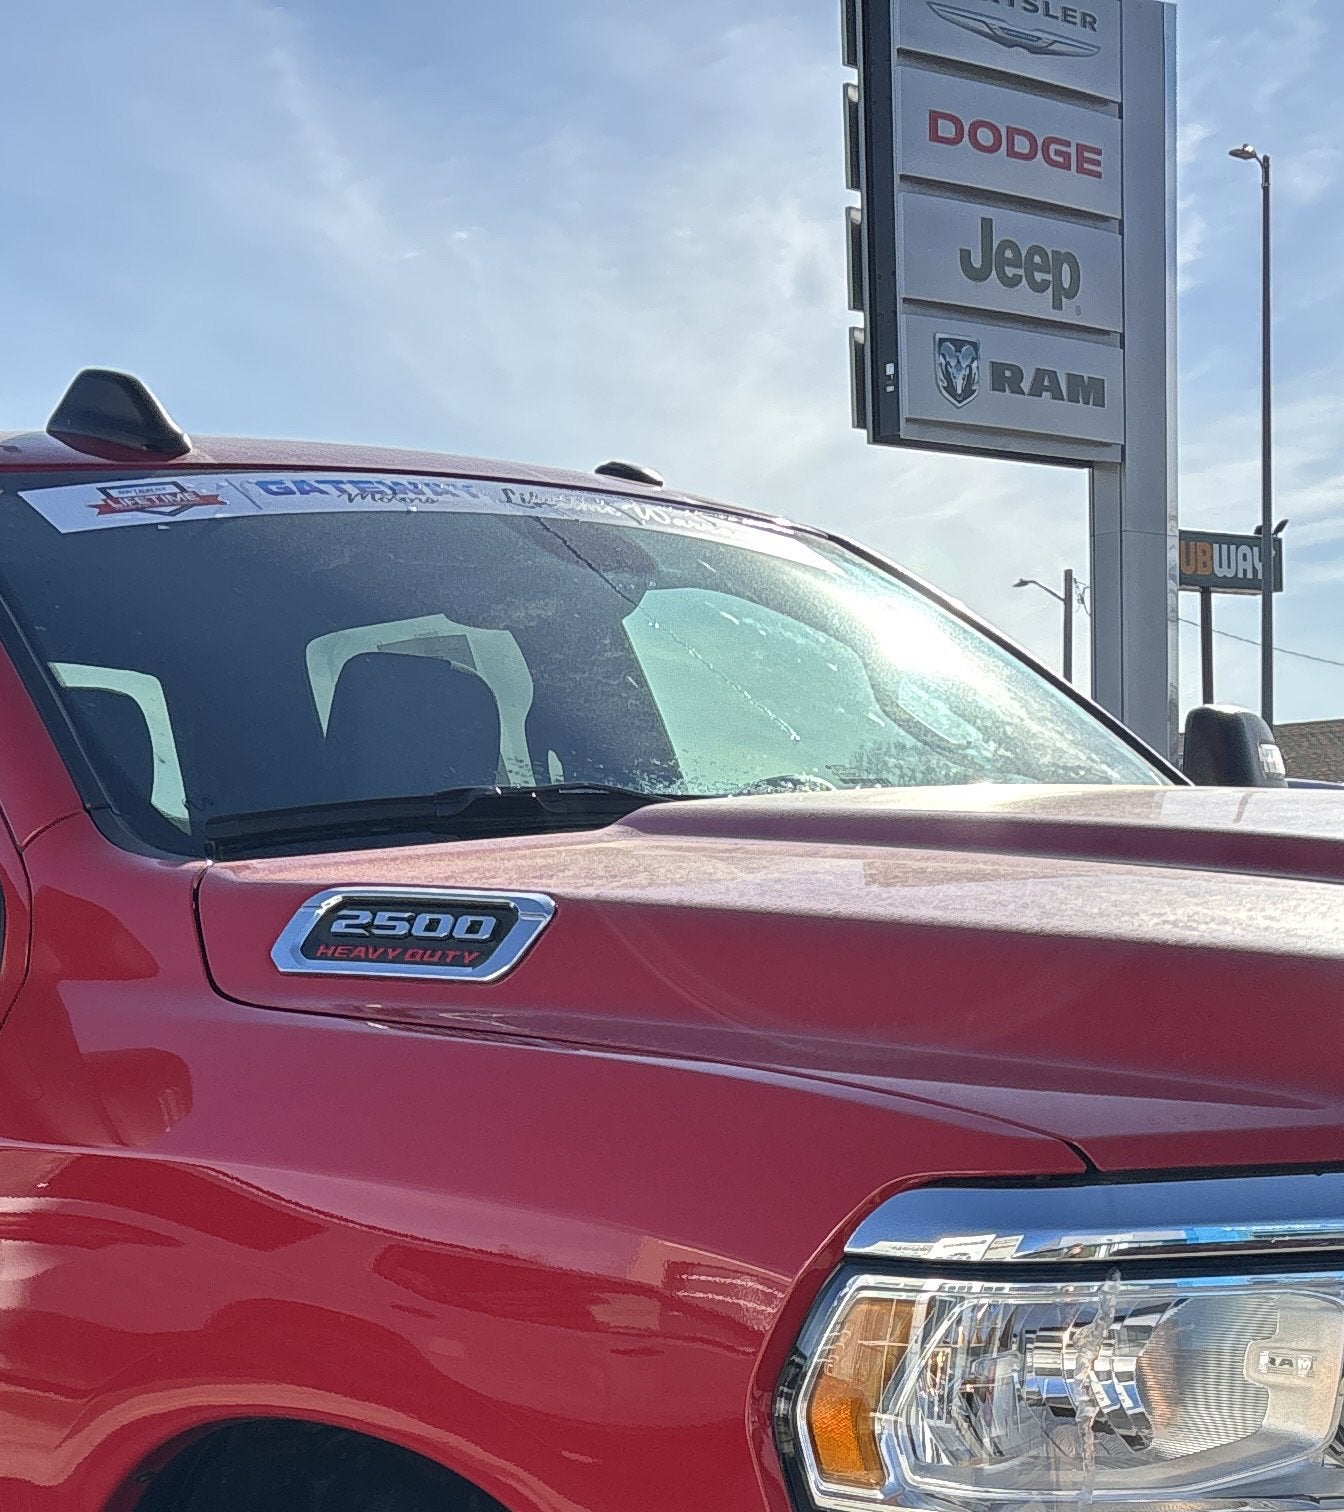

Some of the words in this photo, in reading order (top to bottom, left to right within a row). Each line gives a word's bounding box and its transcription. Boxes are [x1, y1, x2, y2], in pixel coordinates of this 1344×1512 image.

[928, 109, 1103, 179] DODGE
[959, 217, 1081, 311] Jeep
[989, 361, 1106, 408] RAM
[330, 910, 498, 940] 2500
[316, 944, 404, 962] HEAVY
[404, 949, 481, 966] DUTY
